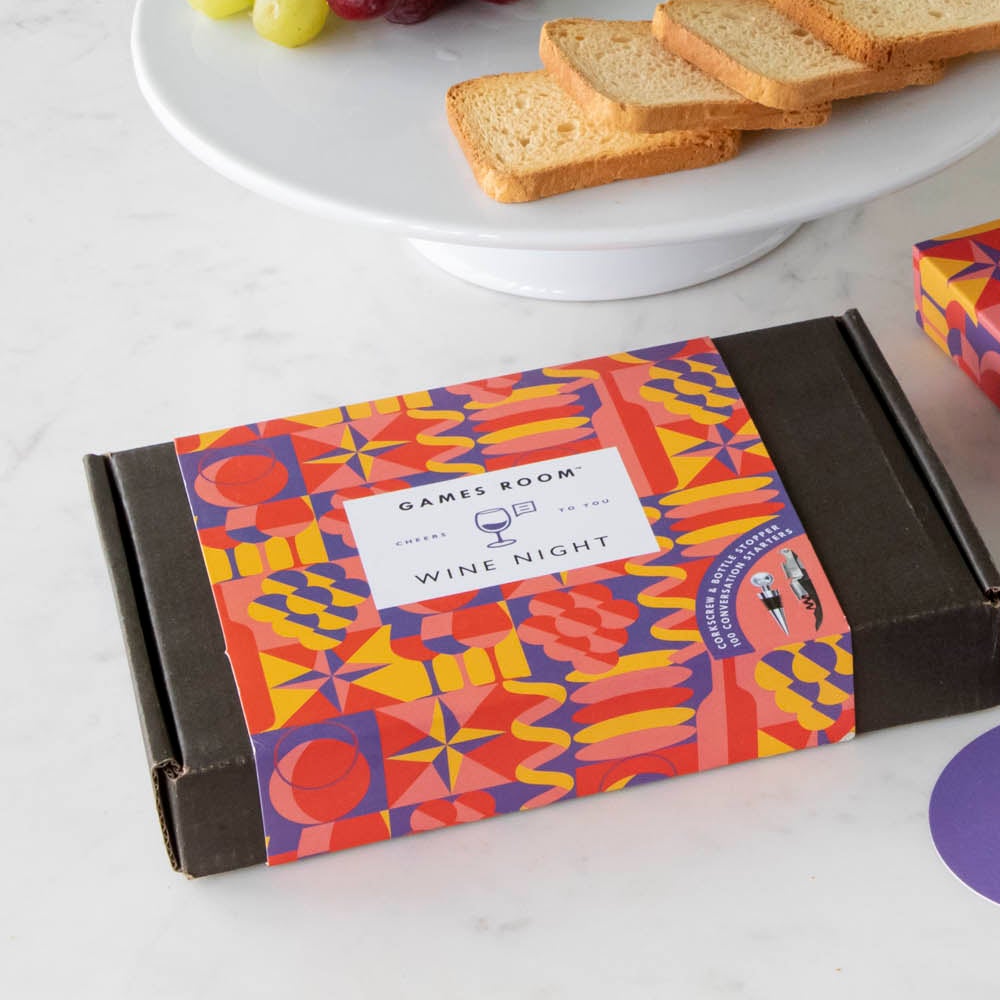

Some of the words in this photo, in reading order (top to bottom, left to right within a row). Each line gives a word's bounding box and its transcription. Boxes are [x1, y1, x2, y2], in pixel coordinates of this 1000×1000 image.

[399, 486, 486, 511] GAMES
[558, 505, 576, 513] TO
[583, 498, 610, 509] YOU
[395, 532, 447, 547] CHEERS
[735, 524, 780, 554] STOPPER
[743, 528, 793, 561] STARTERS
[415, 559, 497, 585] WINE
[513, 535, 609, 566] NIGHT
[711, 554, 737, 584] BOTTLE
[719, 562, 746, 630] CONVERSATION
[705, 597, 727, 649] CORKSCREW
[727, 632, 742, 648] 100
